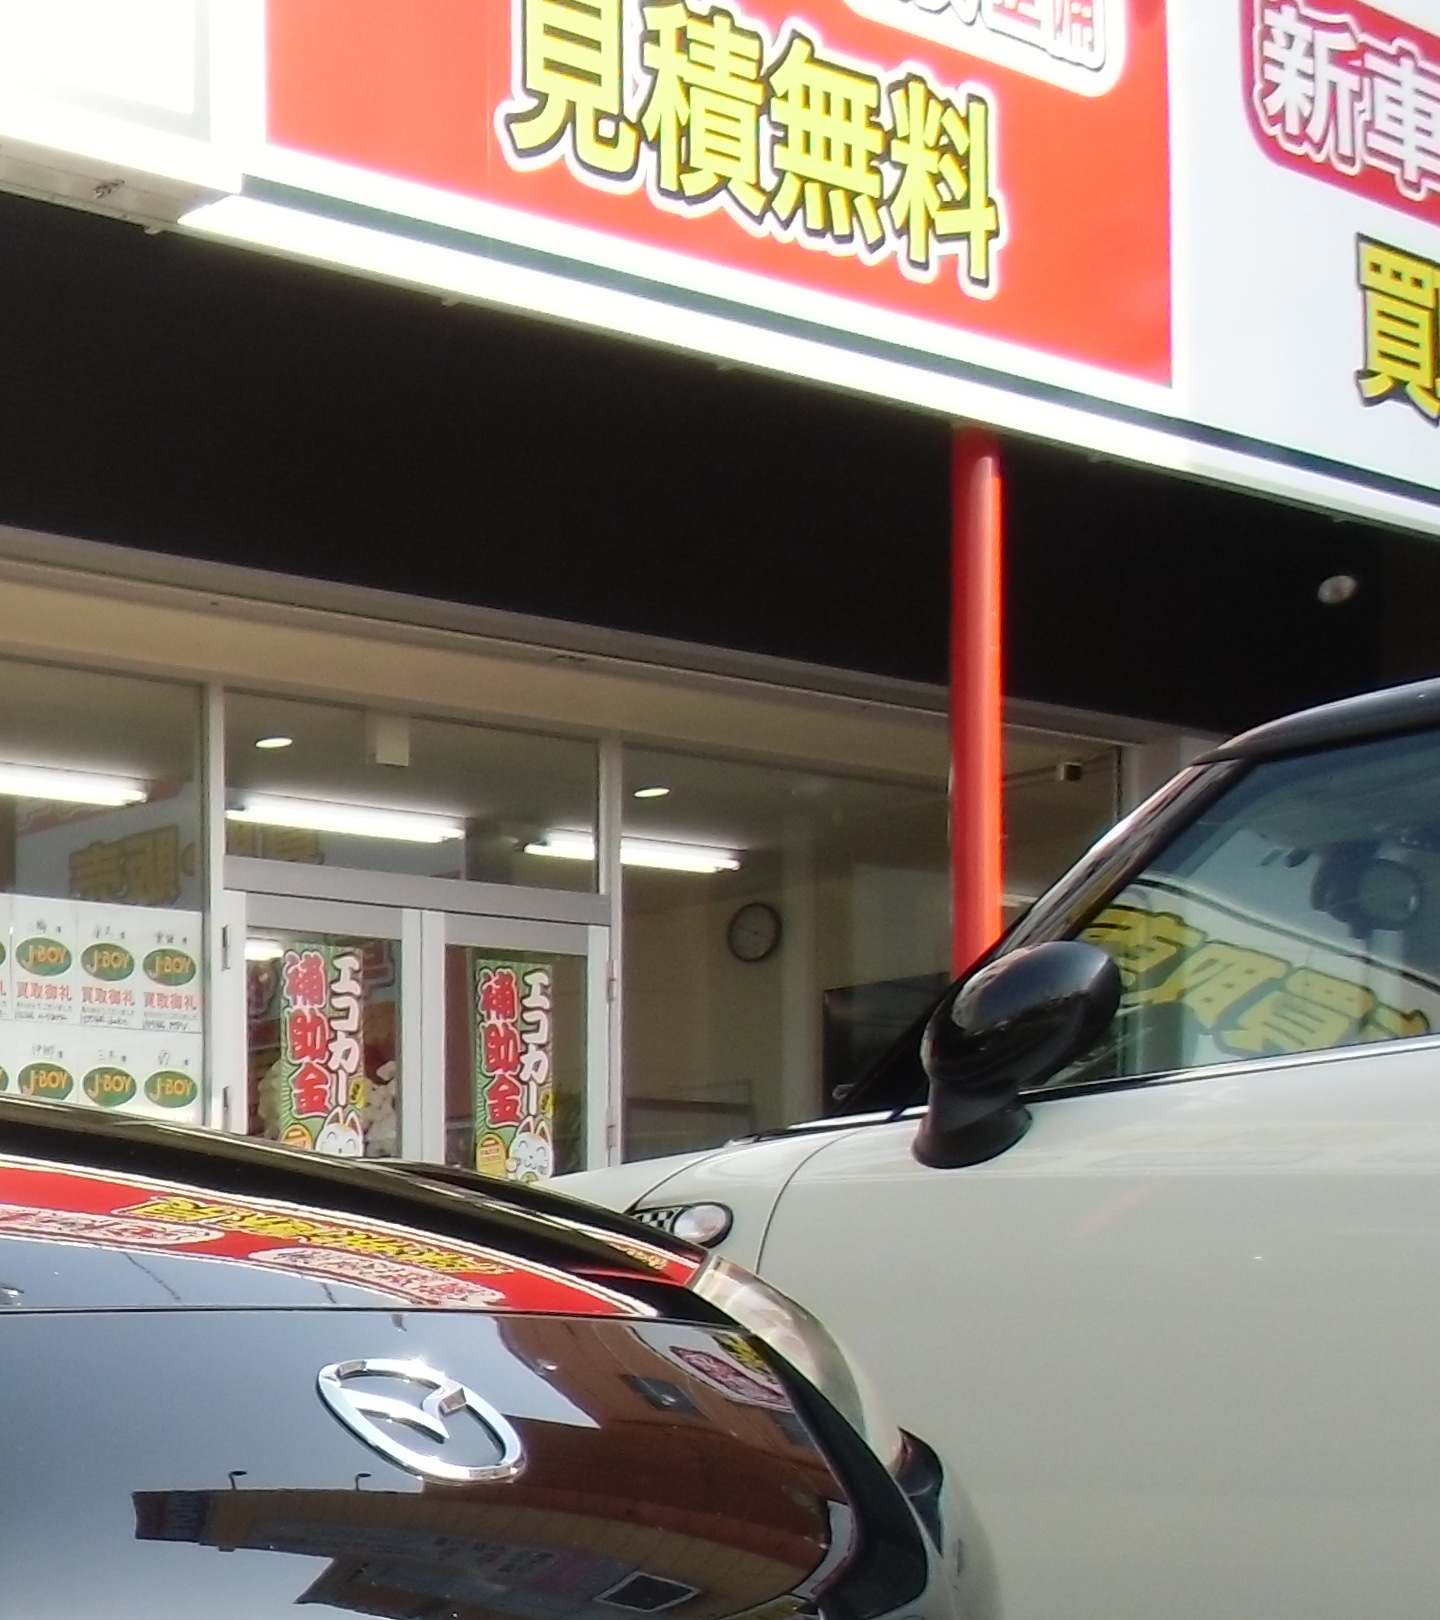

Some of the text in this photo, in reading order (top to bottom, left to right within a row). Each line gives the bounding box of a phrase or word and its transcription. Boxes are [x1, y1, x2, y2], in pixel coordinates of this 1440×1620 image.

[506, 0, 1000, 287] 見積無料
[285, 953, 330, 1117] 補助金
[329, 956, 361, 1106] エコカー
[480, 970, 522, 1126] 補助金
[520, 972, 551, 1115] エコカー
